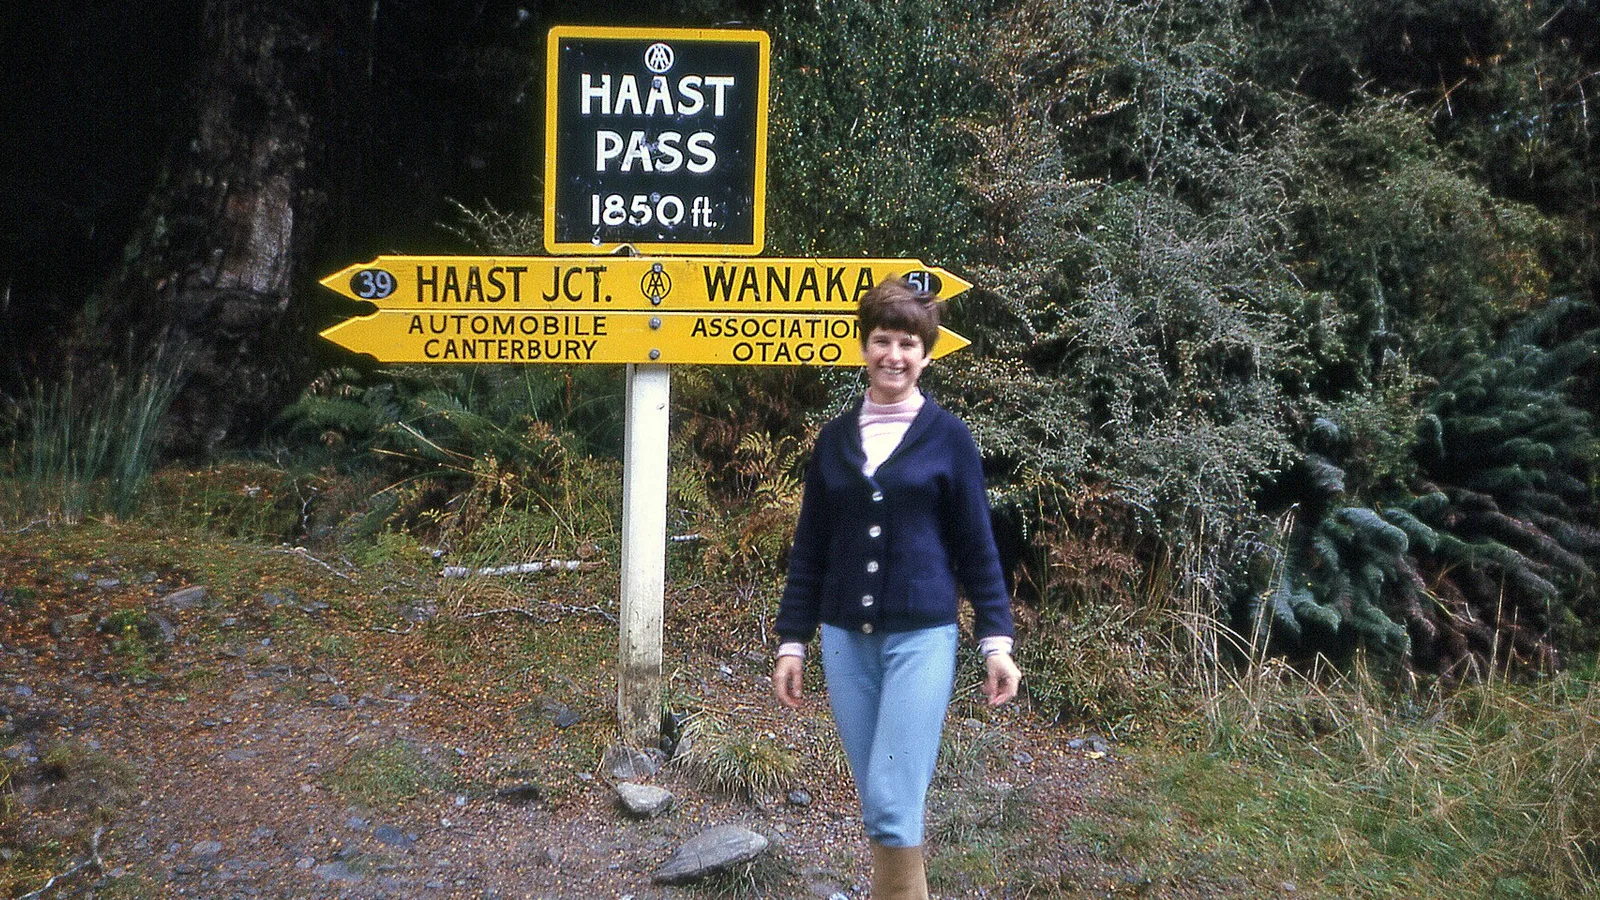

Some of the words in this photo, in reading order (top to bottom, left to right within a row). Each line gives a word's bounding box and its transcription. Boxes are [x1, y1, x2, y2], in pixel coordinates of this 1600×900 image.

[581, 73, 735, 117] HAAST
[596, 130, 718, 173] PASS
[591, 194, 686, 226] 1850
[690, 196, 718, 228] ft.
[359, 271, 393, 298] 39
[416, 266, 528, 303] HAAST
[541, 266, 612, 303] JCT.
[703, 265, 874, 302] WANAKA
[907, 272, 931, 295] 51
[408, 315, 607, 335] AUTOMOBILE
[424, 339, 598, 360] CANTERBURY
[733, 342, 842, 363] OTAGO
